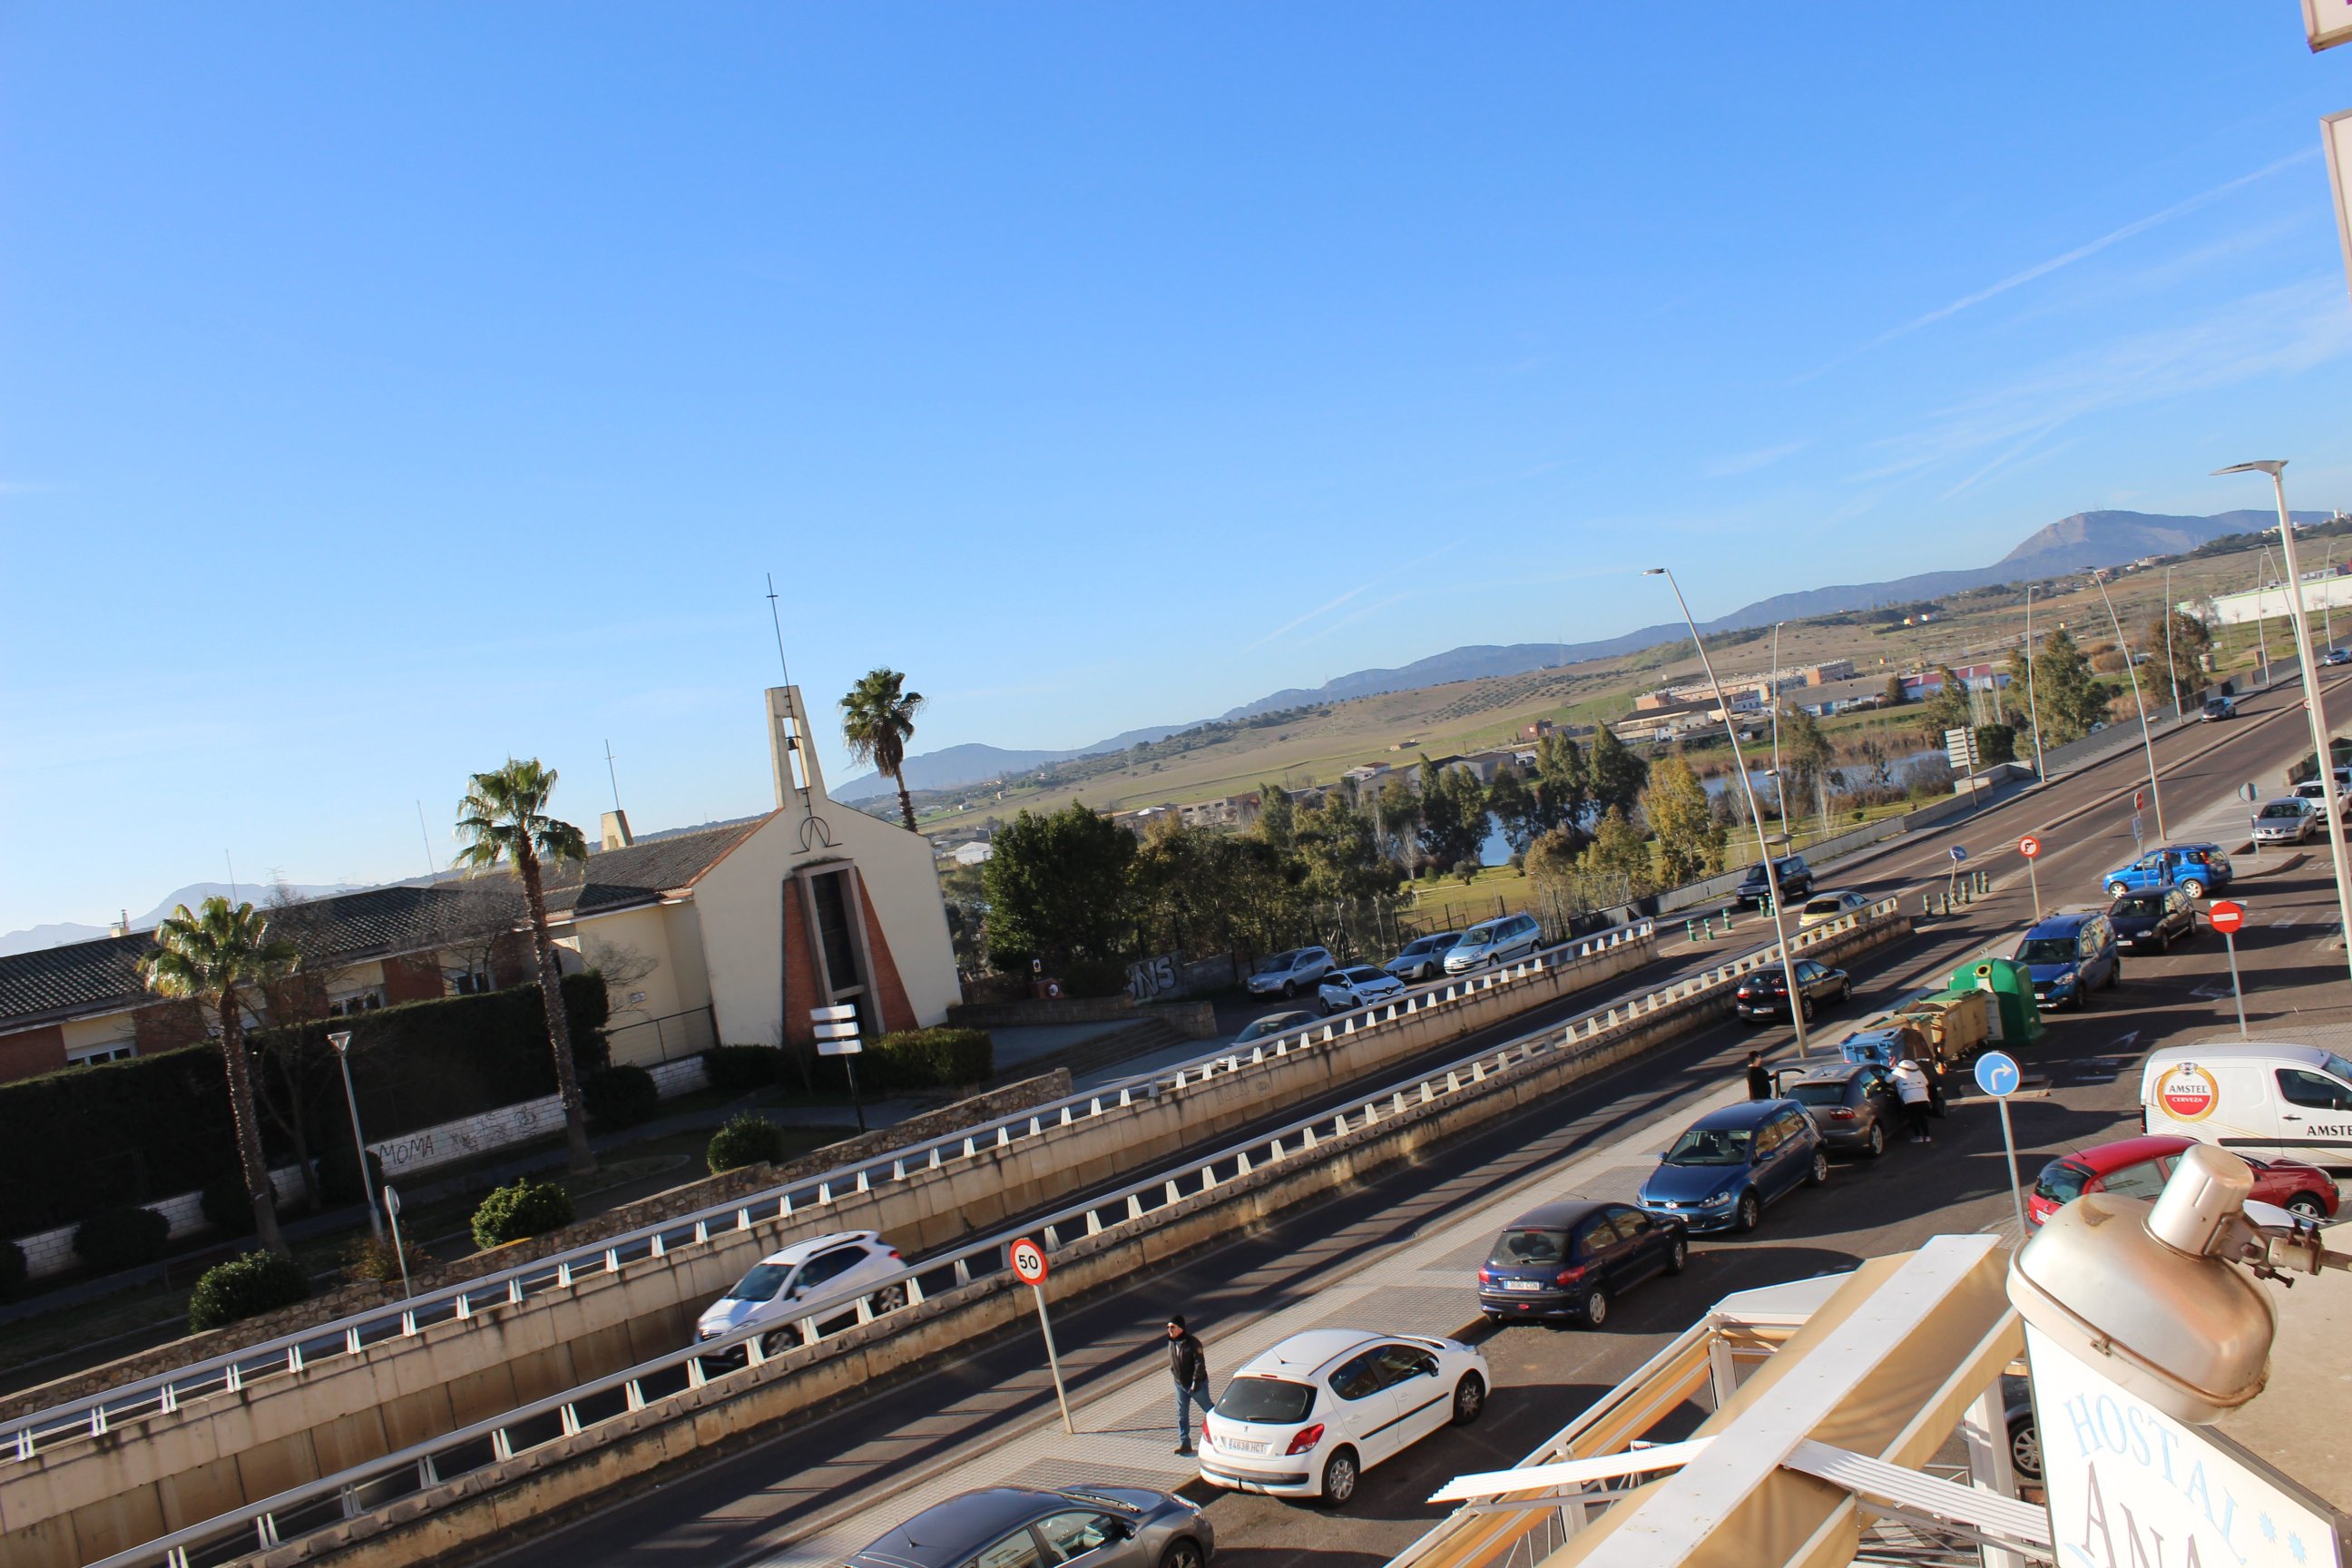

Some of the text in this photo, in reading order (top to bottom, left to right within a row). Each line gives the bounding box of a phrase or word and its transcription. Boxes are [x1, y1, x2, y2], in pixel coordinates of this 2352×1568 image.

[2169, 1084, 2208, 1093] AMSTEL
[378, 1134, 434, 1164] MOMA
[1018, 1255, 1038, 1269] 50
[1232, 1440, 1250, 1451] 4638
[2063, 1393, 2247, 1565] HOSTAL
